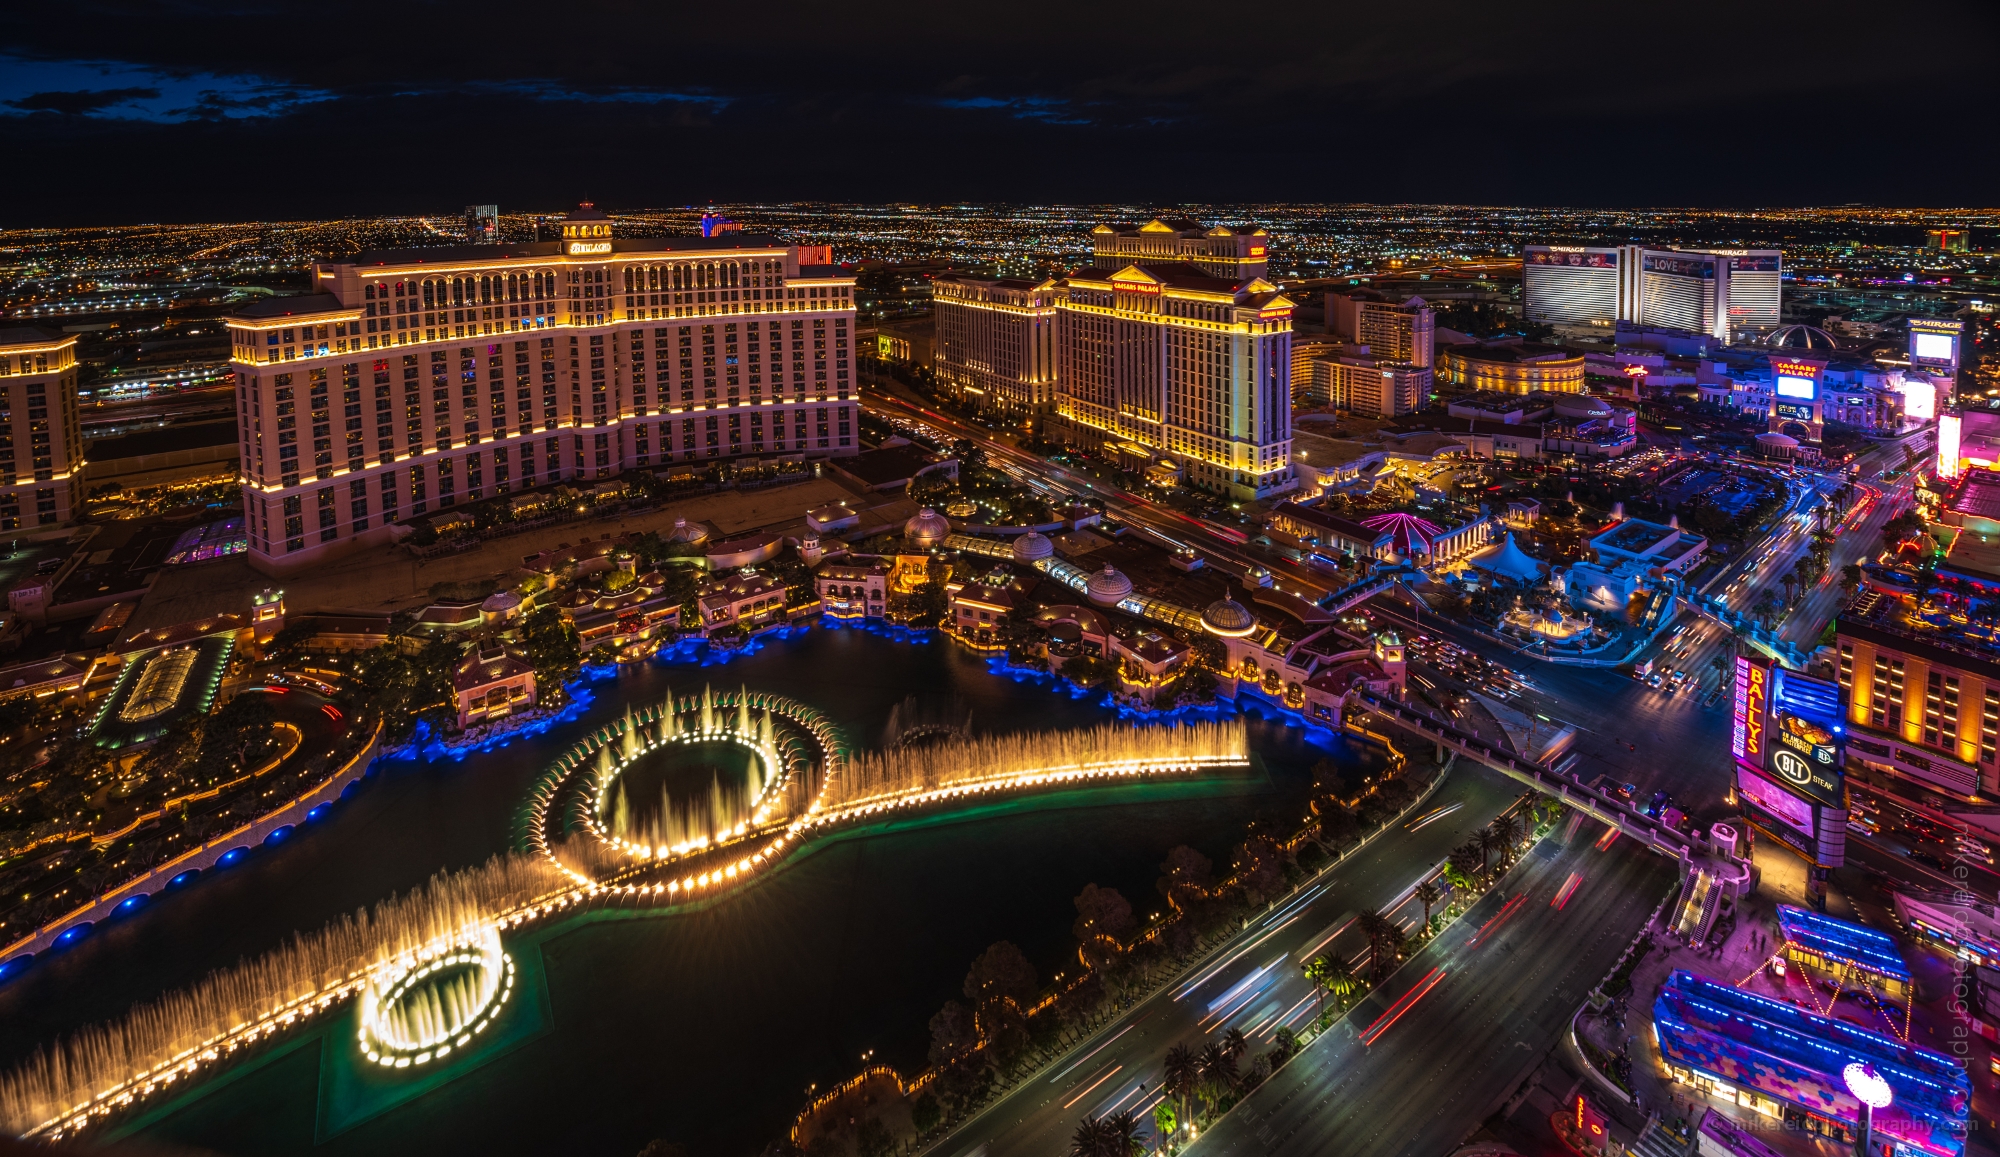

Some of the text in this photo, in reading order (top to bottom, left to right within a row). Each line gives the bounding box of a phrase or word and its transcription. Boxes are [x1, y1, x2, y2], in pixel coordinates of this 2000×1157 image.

[1654, 259, 1678, 272] LOVE
[1113, 282, 1159, 293] CAESARS PALACE
[1920, 320, 1962, 329] MIRAGE
[1777, 362, 1817, 372] CAESARS
[1779, 368, 1814, 378] PALACE
[1782, 737, 1812, 756] MASTERPIECE
[1790, 733, 1813, 750] AMERICAN
[1782, 754, 1804, 779] BLT
[1812, 775, 1833, 791] STEAK
